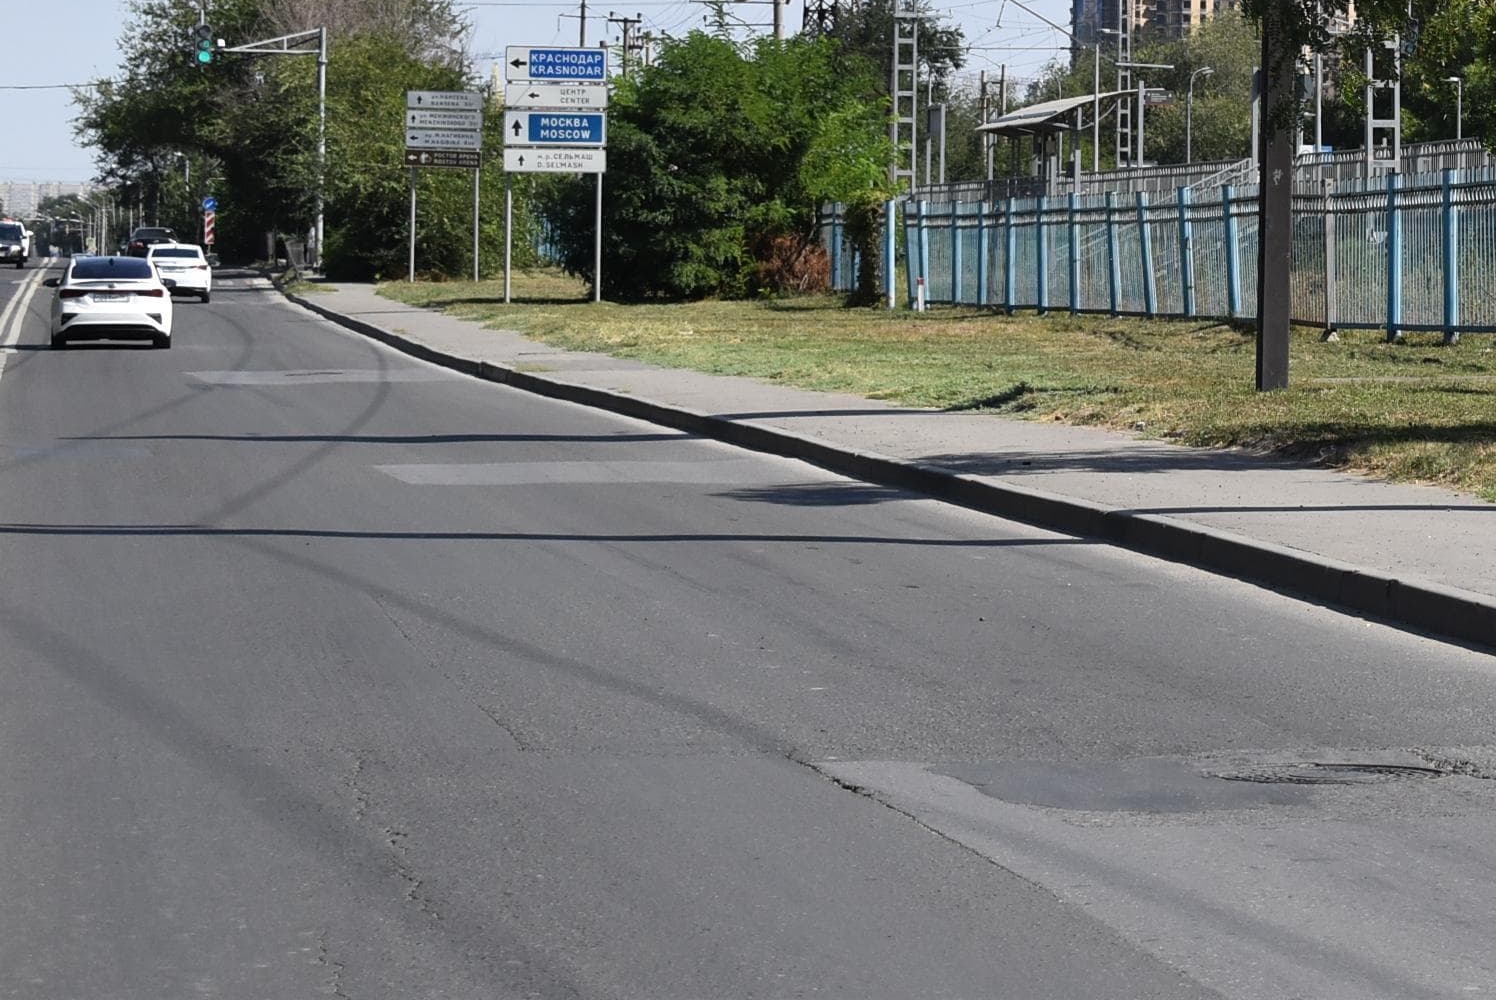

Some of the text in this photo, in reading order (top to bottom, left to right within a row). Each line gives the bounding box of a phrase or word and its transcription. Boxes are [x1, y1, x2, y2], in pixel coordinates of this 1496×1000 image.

[531, 53, 602, 65] КРАСНОДАР
[531, 65, 602, 75] KRASNODAR
[560, 88, 586, 96] ЦЕНТР
[540, 117, 589, 127] МОСКВА
[540, 129, 591, 139] MOSCOW
